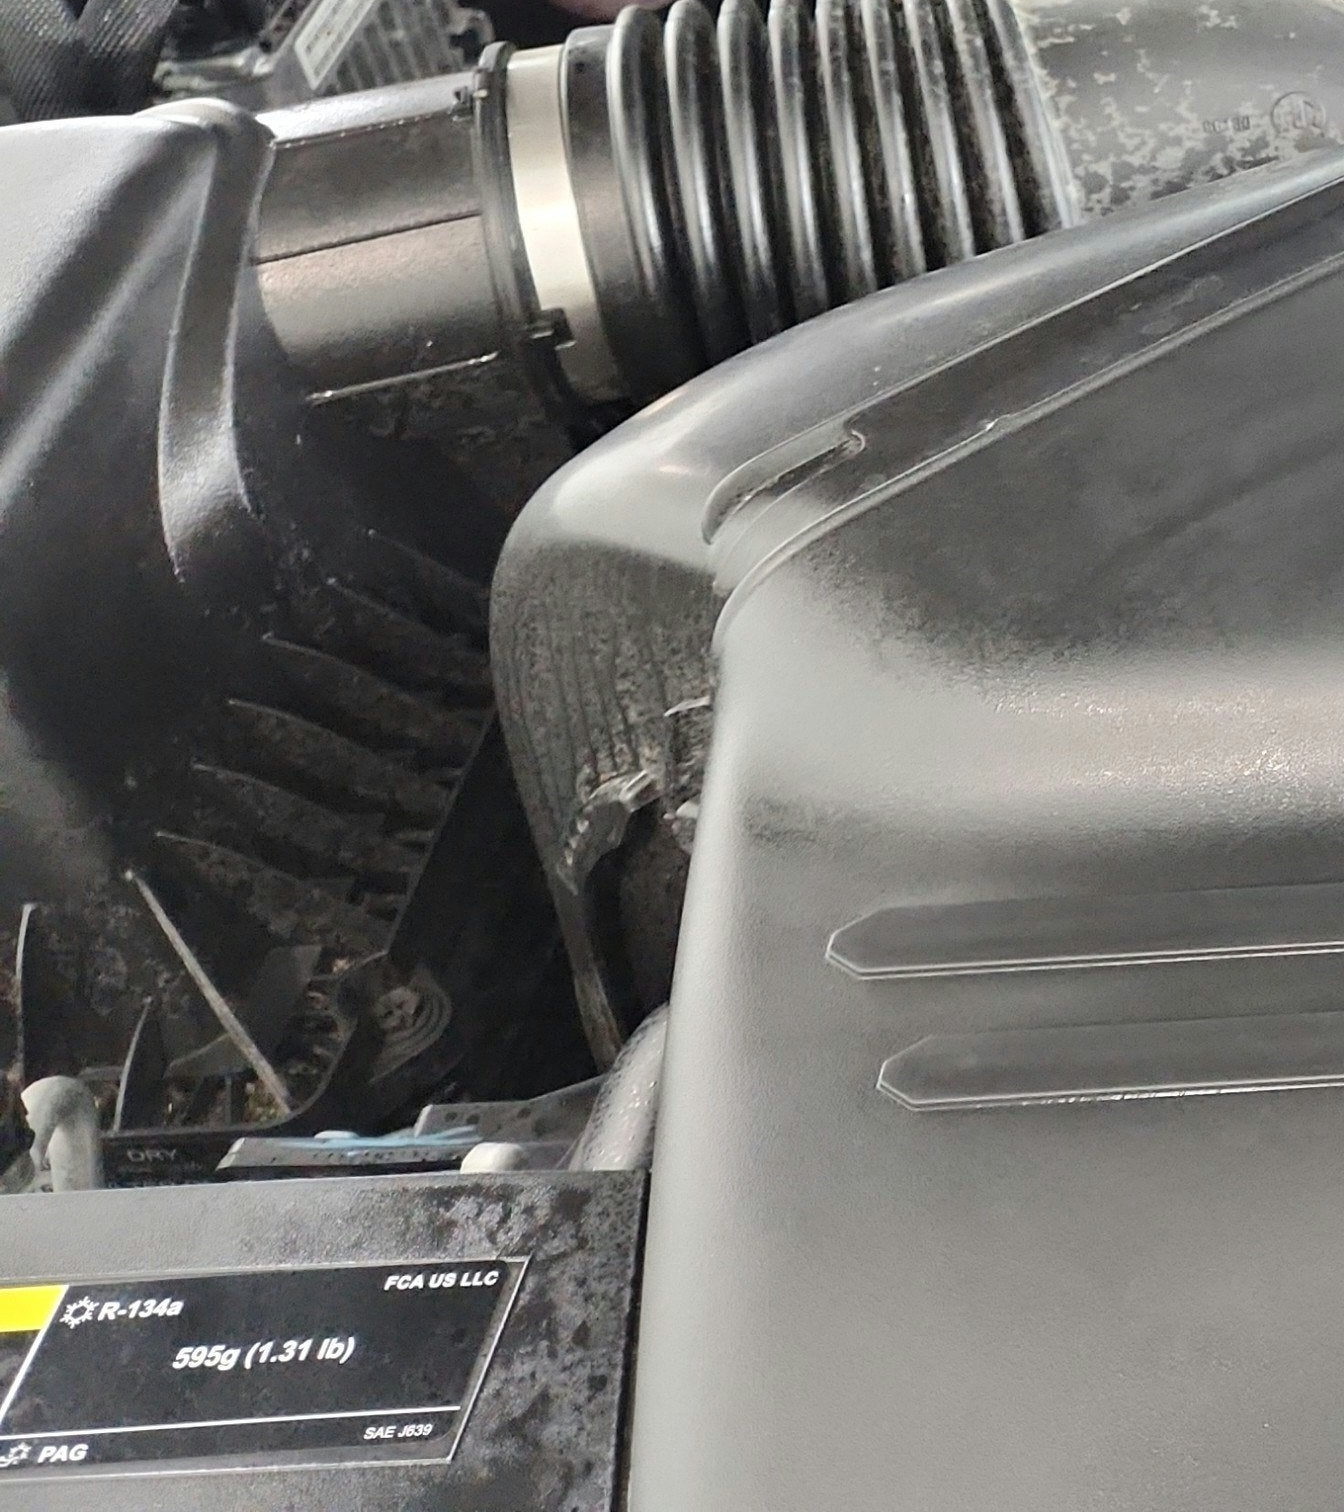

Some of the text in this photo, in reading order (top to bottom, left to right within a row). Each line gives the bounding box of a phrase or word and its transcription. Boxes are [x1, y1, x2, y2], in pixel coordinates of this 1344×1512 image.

[383, 1270, 500, 1291] FCA US LLC
[97, 1298, 185, 1322] R-134a
[171, 1336, 356, 1372] 595g (1.31 lb)
[362, 1422, 434, 1441] SAE J639
[37, 1443, 89, 1464] PAG
